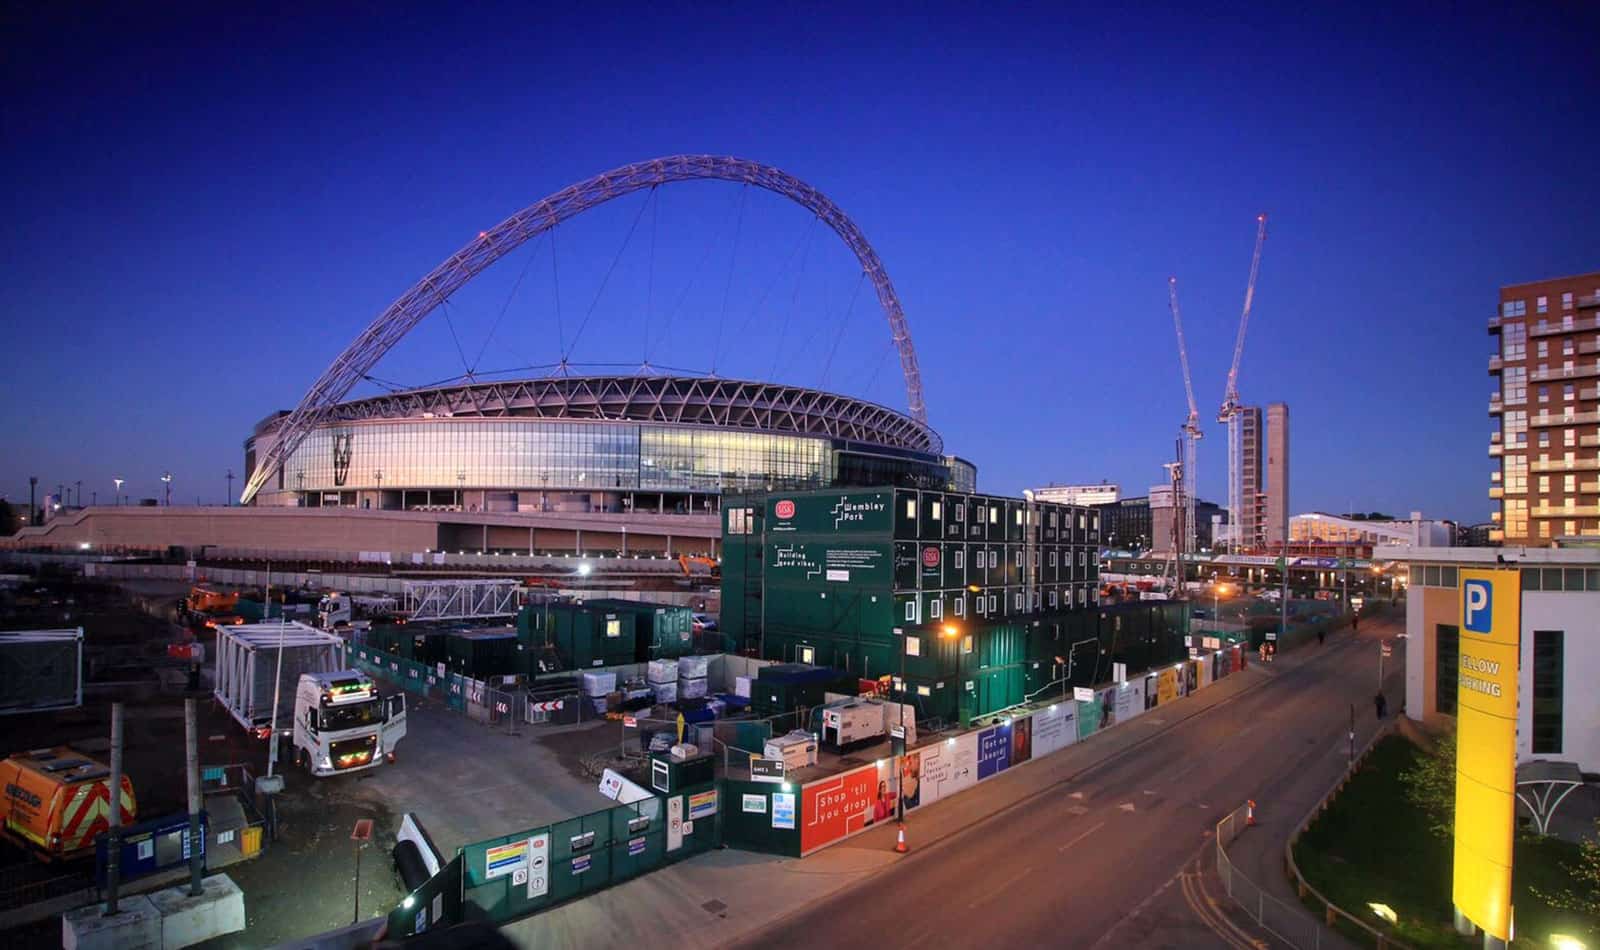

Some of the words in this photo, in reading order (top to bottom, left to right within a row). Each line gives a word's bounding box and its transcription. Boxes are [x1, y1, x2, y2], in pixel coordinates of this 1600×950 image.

[844, 502, 885, 511] Wembley
[844, 512, 864, 521] Park
[780, 551, 806, 560] Building
[1466, 583, 1488, 626] P
[1463, 655, 1499, 675] ELLOW
[1460, 674, 1501, 697] ARKING
[820, 792, 846, 807] Shop
[820, 809, 839, 824] you
